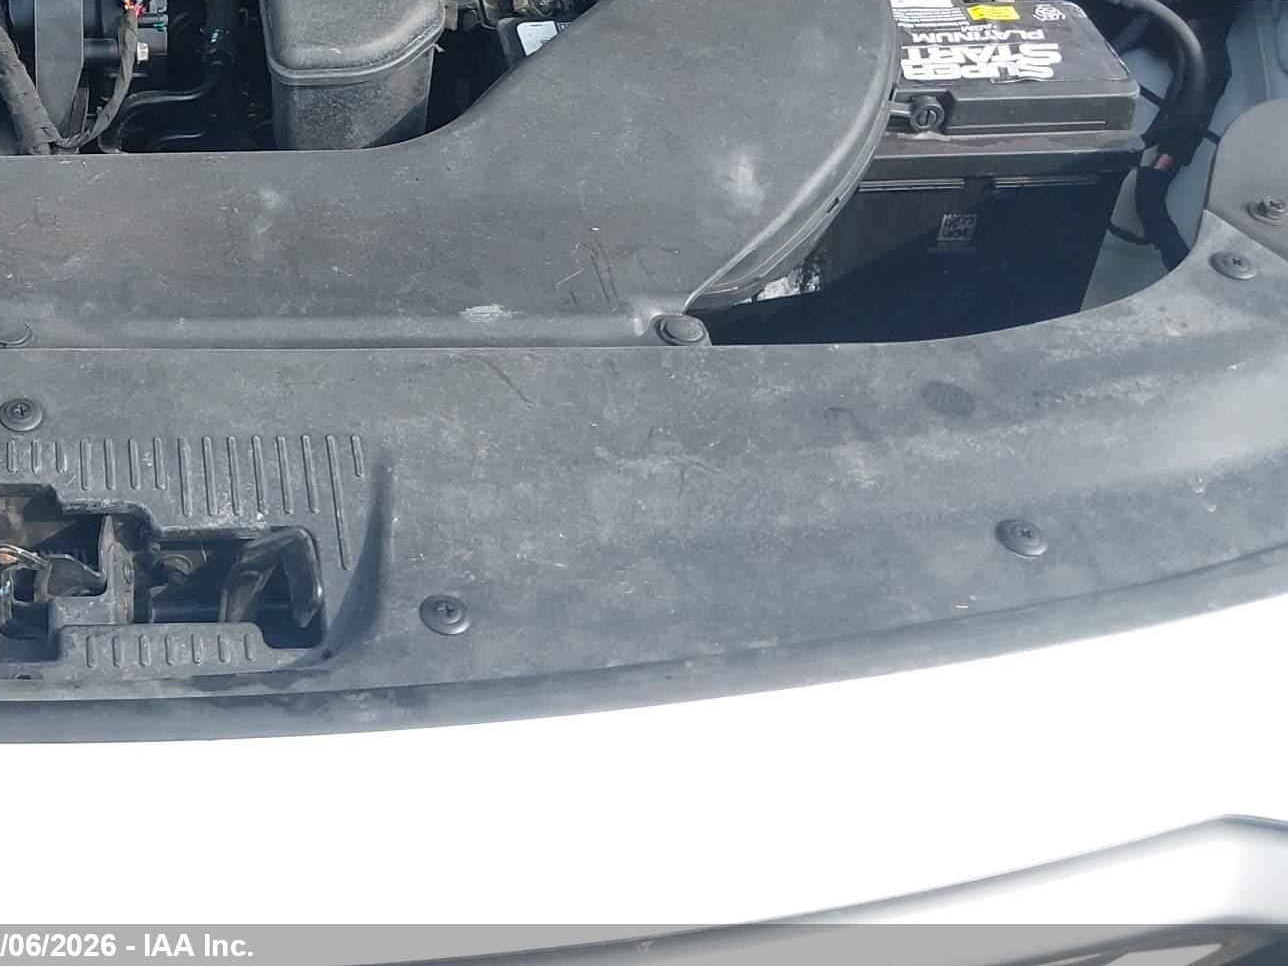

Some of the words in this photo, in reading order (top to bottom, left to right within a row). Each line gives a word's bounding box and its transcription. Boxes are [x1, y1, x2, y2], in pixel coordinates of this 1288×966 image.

[911, 29, 1046, 44] PLATINUM
[901, 43, 1062, 65] START
[902, 61, 1055, 80] SUPER
